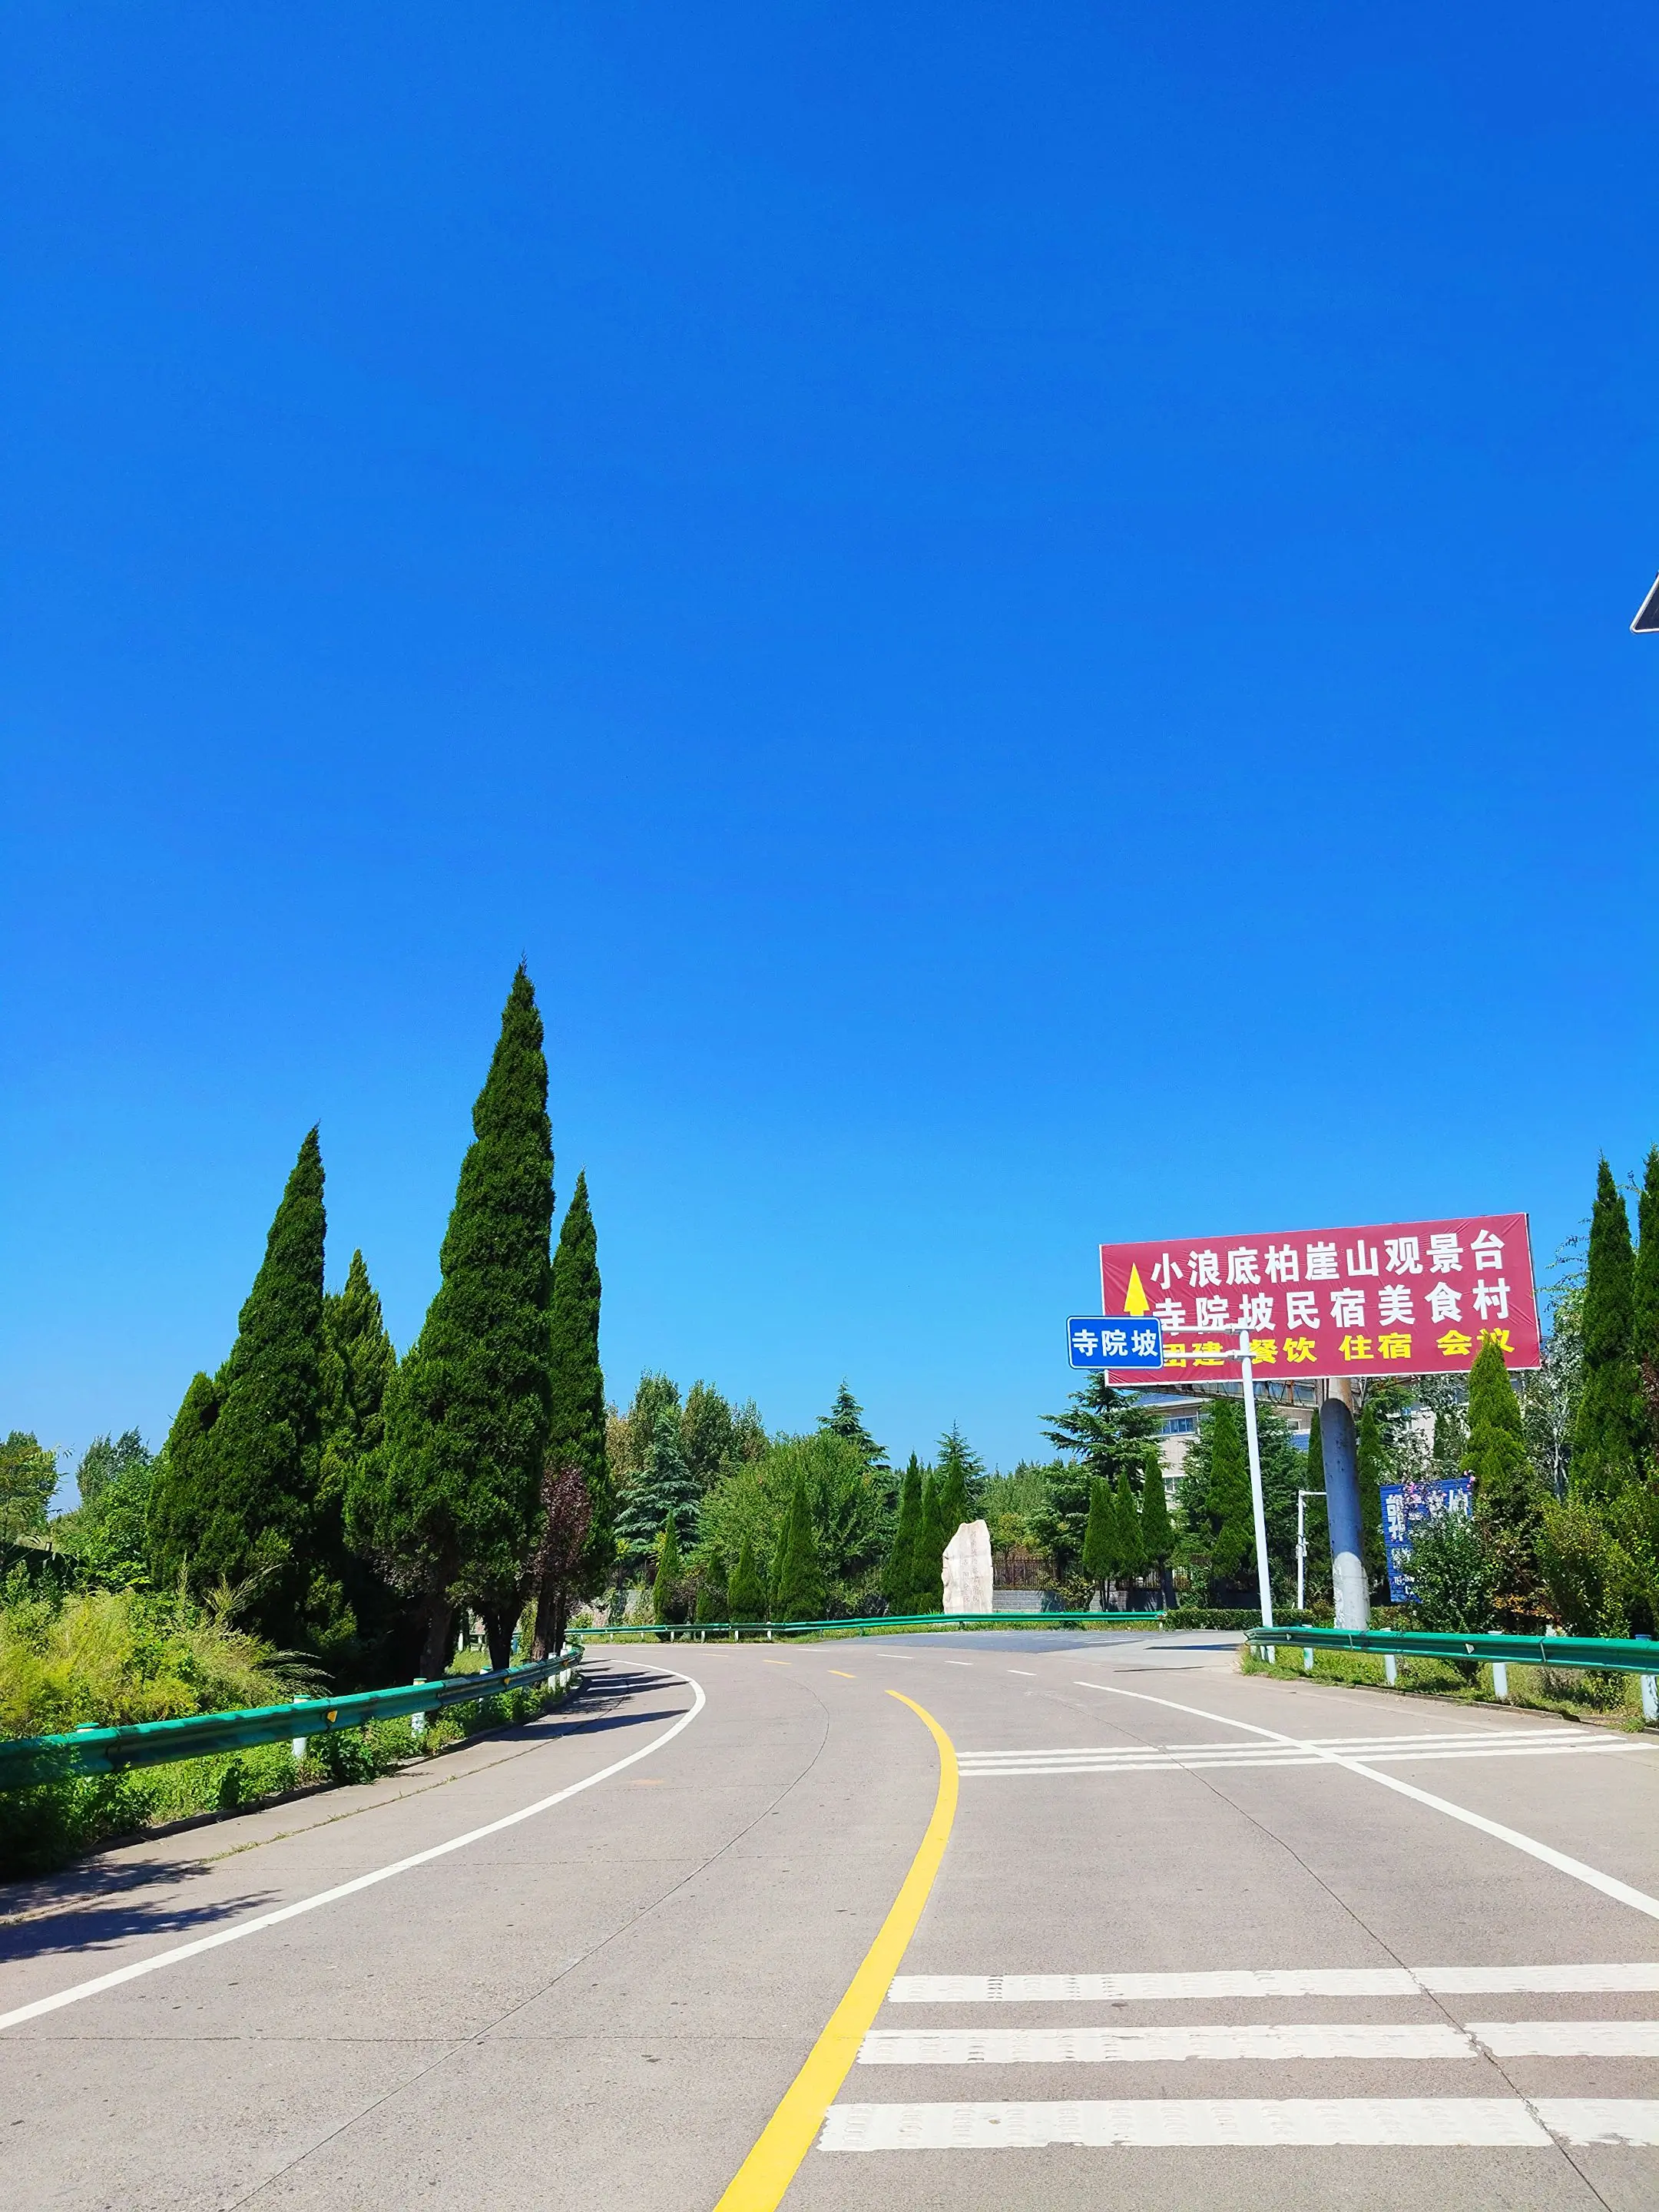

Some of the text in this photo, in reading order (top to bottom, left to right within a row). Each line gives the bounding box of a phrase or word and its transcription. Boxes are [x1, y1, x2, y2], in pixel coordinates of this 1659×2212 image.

[1151, 1229, 1505, 1290] 小浪底柏崖山观景台
[1152, 1278, 1511, 1336] 寺院坡民宿美食村
[1071, 1329, 1158, 1357] 寺院坡
[1249, 1336, 1318, 1365] 餐饮
[1339, 1332, 1412, 1361] 住宿
